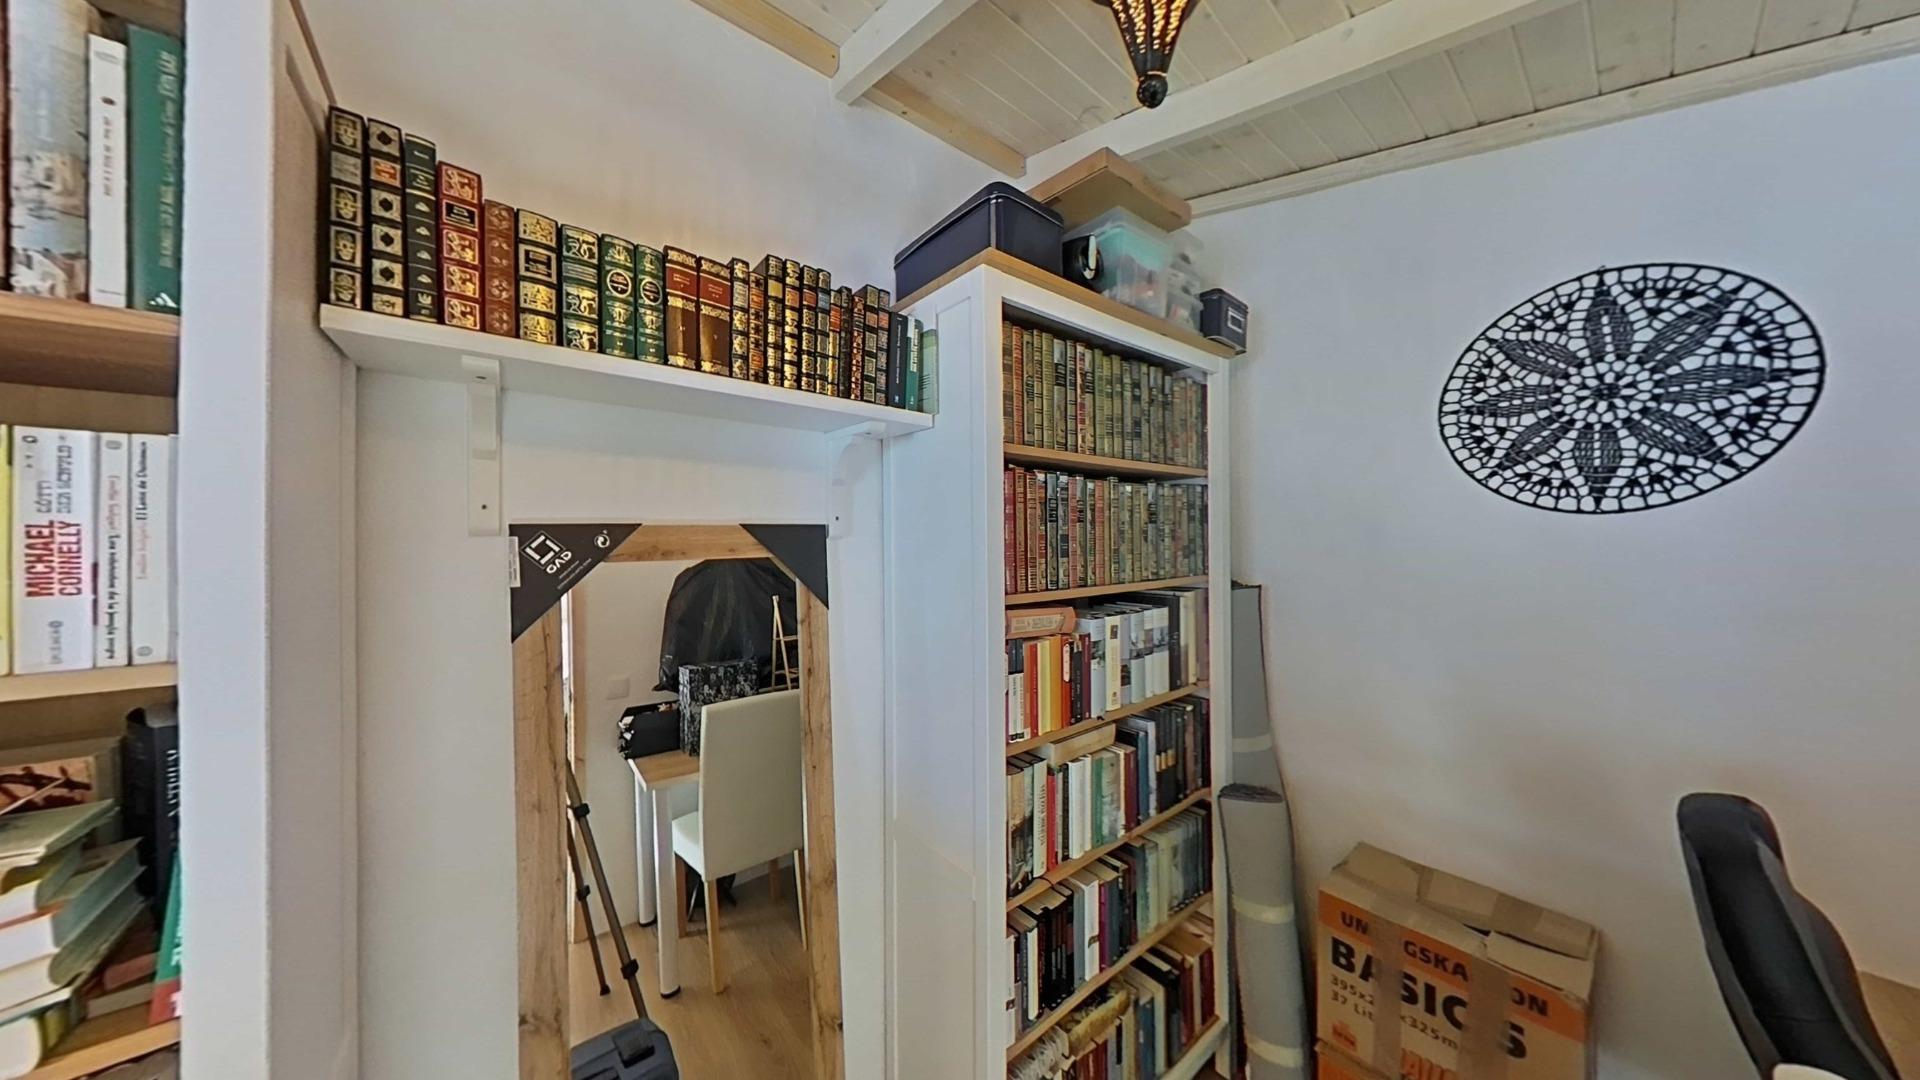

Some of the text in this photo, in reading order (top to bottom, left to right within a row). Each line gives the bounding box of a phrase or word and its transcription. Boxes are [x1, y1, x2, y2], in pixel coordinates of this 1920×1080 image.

[25, 519, 56, 598] MICHAEL
[56, 519, 83, 597] CONNELLY
[1330, 990, 1376, 1022] 37 Lit
